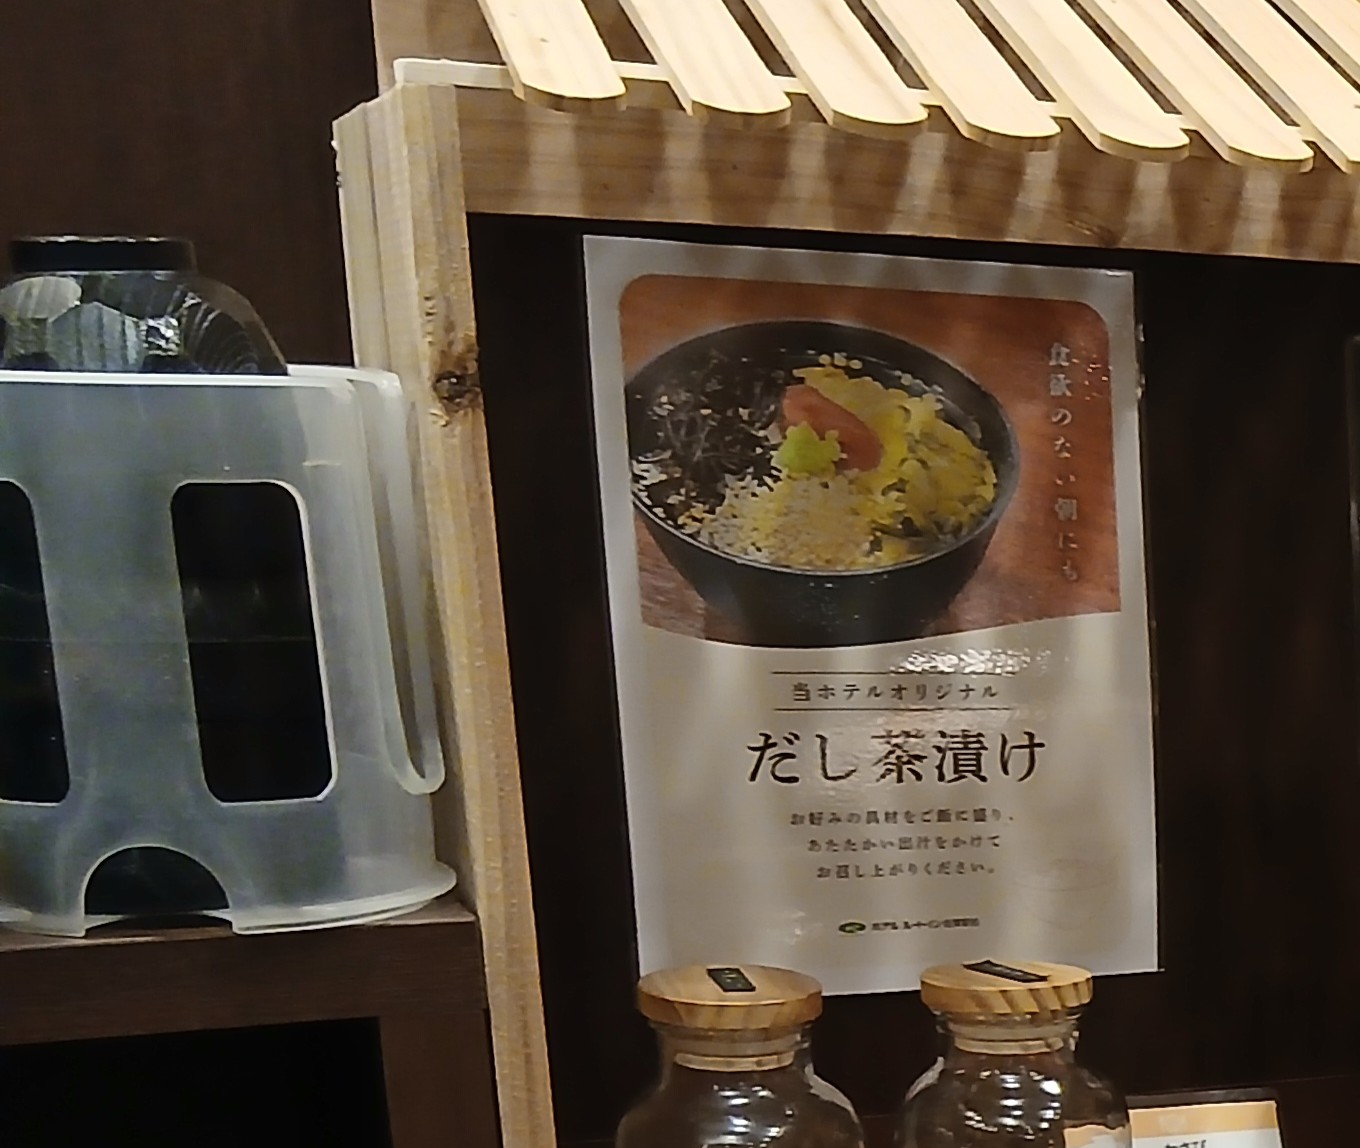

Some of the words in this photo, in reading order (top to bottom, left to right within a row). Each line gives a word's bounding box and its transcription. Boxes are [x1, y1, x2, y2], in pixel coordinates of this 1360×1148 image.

[792, 681, 1000, 703] 当ホテルオリジナル
[745, 729, 1047, 785] だし茶漬け
[807, 835, 1001, 853] あたたかい出汁をかけて
[816, 861, 996, 879] お召し上がりください。
